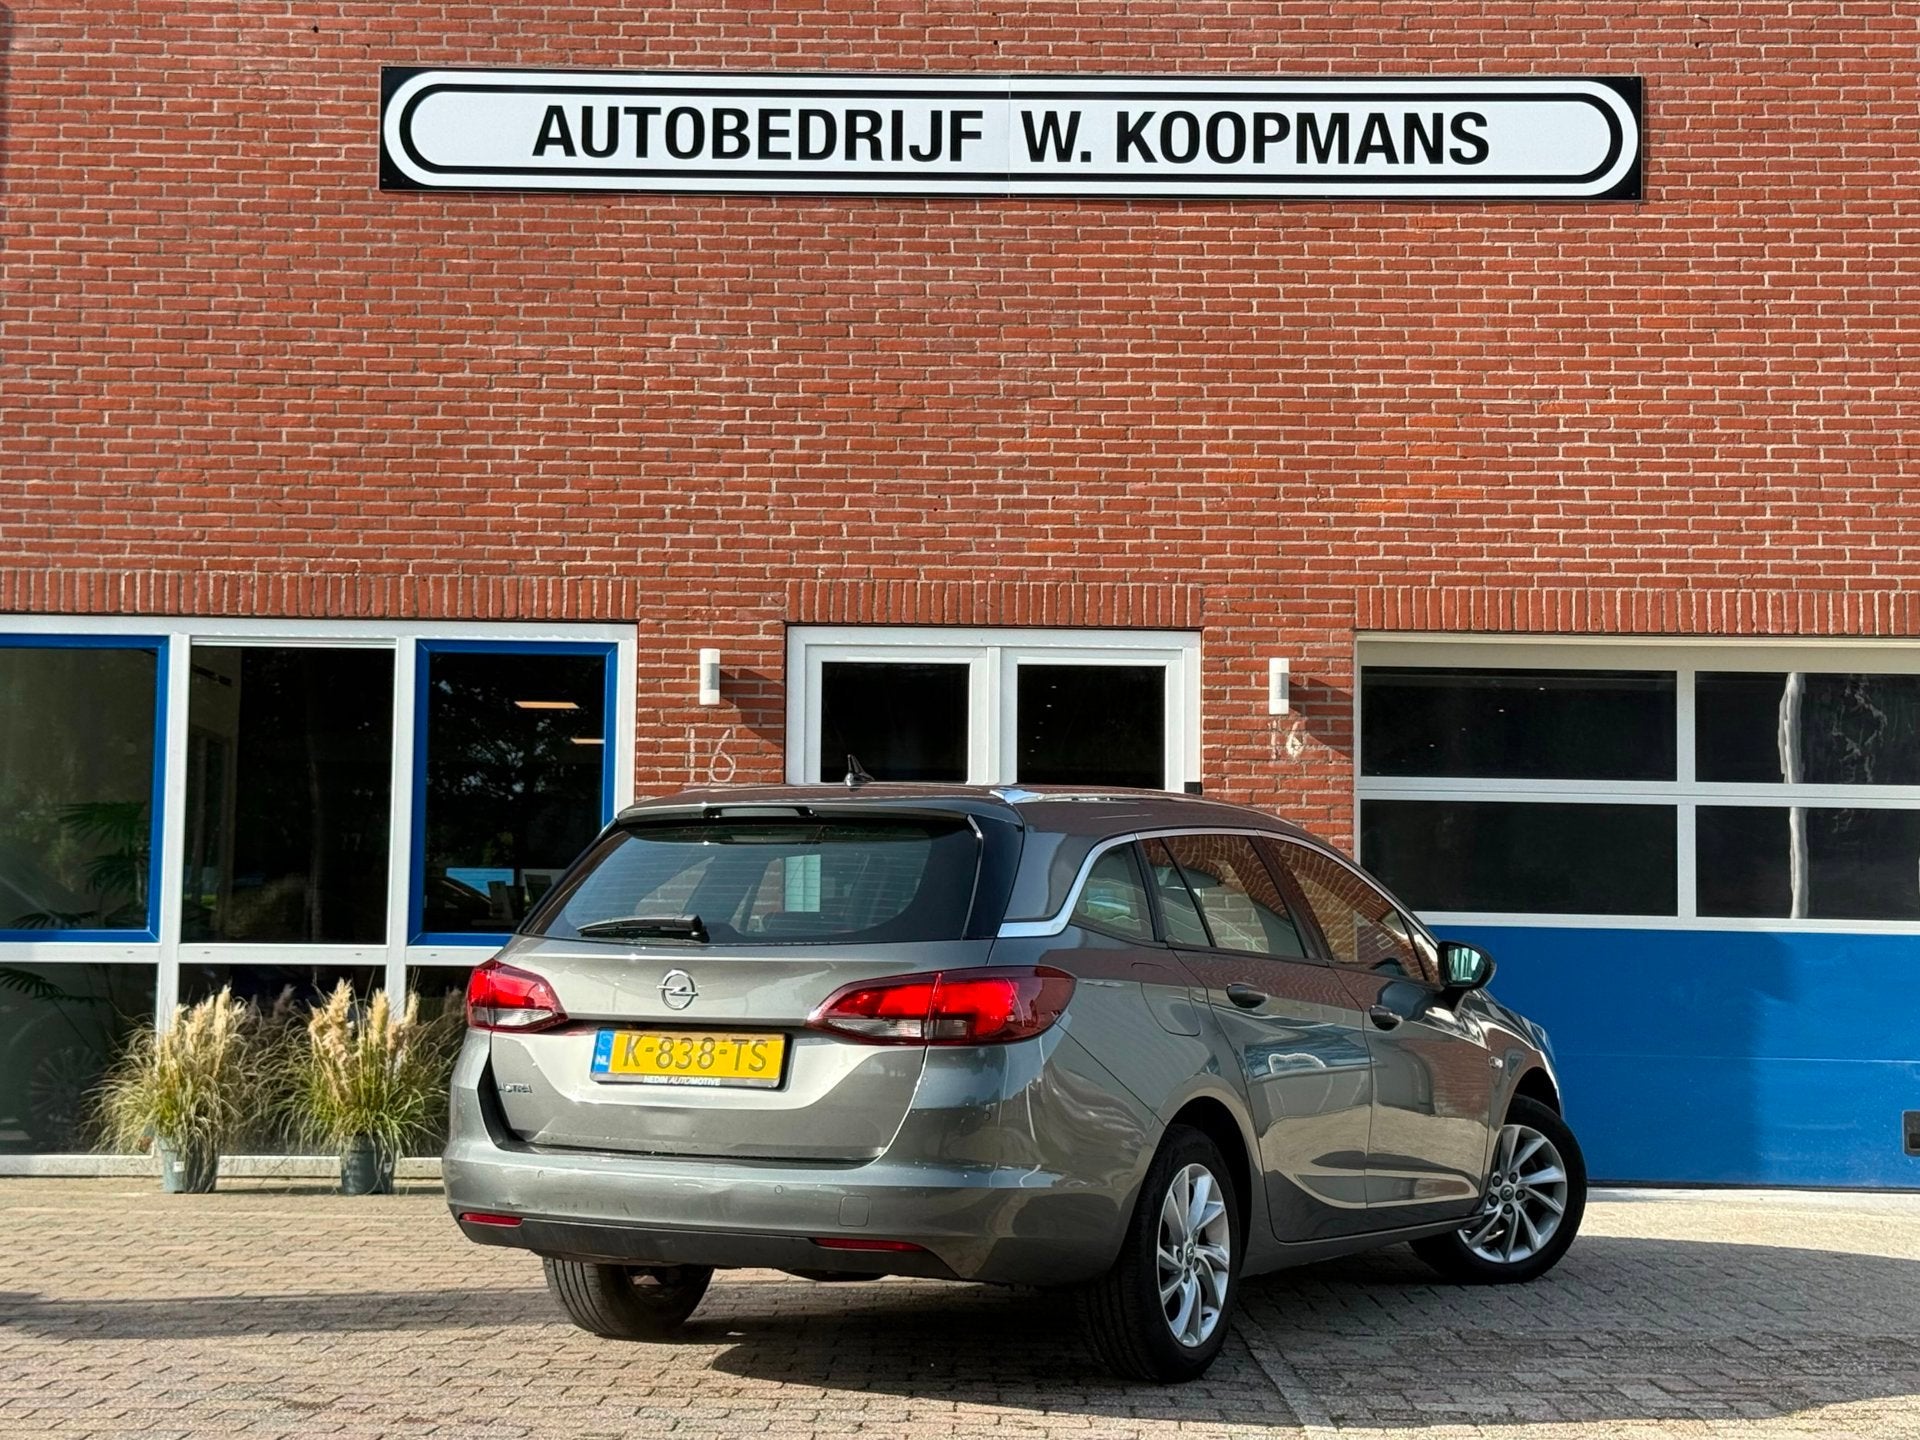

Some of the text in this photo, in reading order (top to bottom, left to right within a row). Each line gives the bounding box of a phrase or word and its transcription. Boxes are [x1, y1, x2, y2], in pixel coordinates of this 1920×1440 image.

[532, 105, 1490, 165] AUTOBEDRIJF W. KOOPMANS
[689, 728, 736, 782] 16
[595, 1055, 609, 1066] NL
[622, 1034, 768, 1072] K-838-TS
[668, 1076, 721, 1087] AUTOMOTIVE
